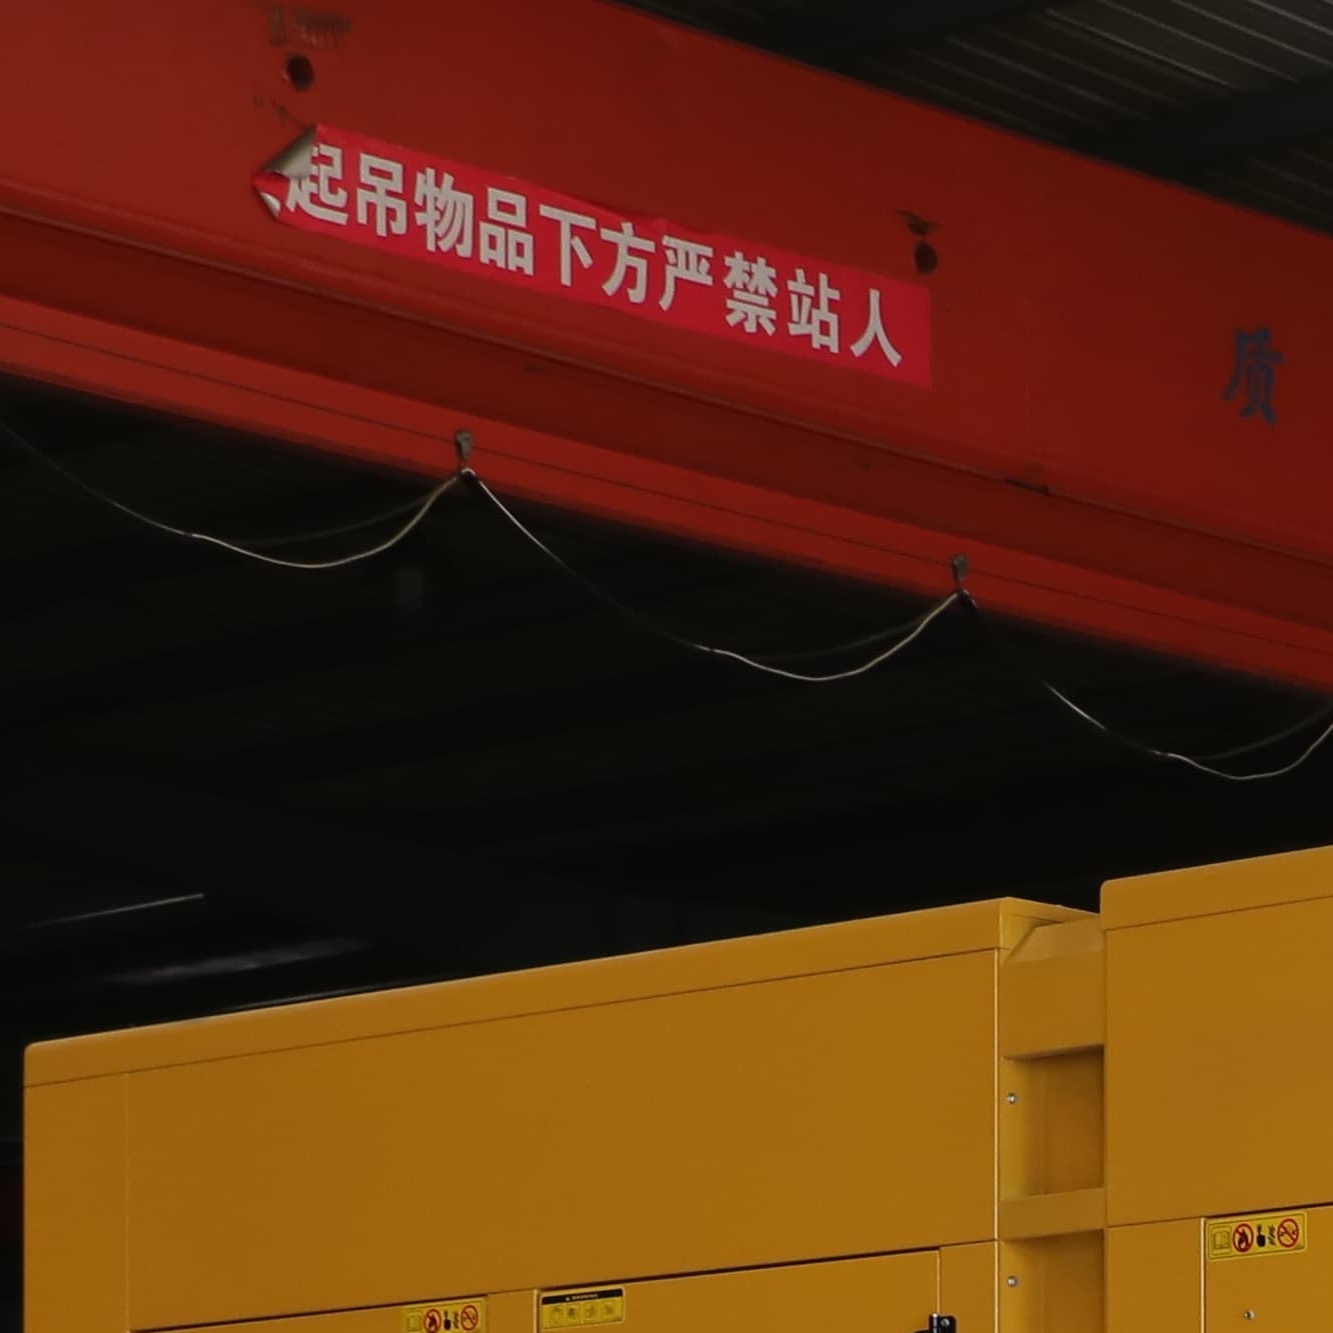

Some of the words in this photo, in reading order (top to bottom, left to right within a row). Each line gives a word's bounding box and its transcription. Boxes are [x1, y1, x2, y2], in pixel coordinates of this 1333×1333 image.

[286, 143, 903, 367] 起吊物品下方严禁站人
